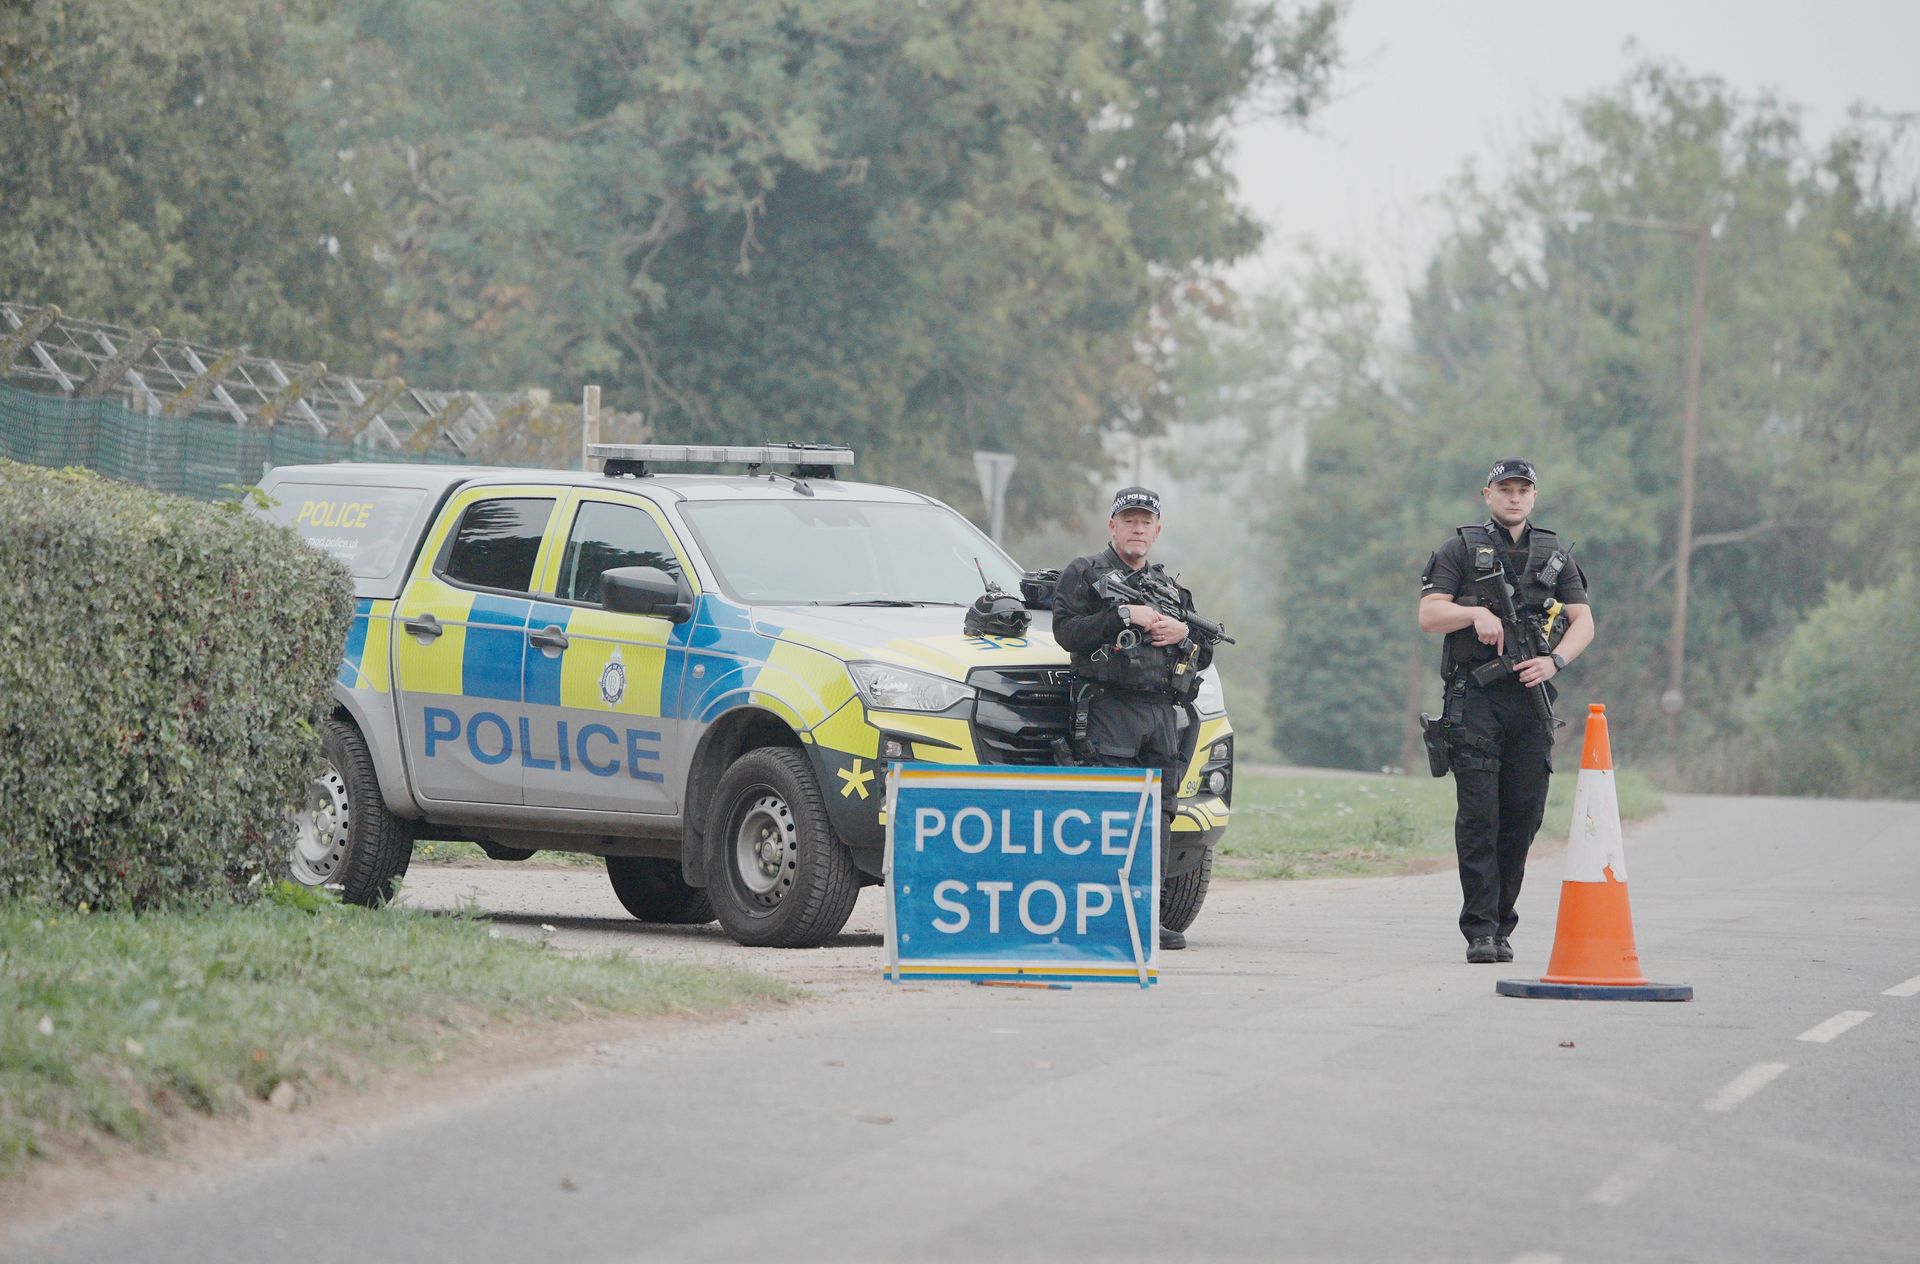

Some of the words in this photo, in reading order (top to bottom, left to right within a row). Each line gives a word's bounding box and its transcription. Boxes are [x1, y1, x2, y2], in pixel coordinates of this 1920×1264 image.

[299, 501, 375, 529] POLICE
[423, 706, 665, 783] POLICE
[915, 806, 1131, 856] POLICE
[931, 879, 1113, 936] STOP
